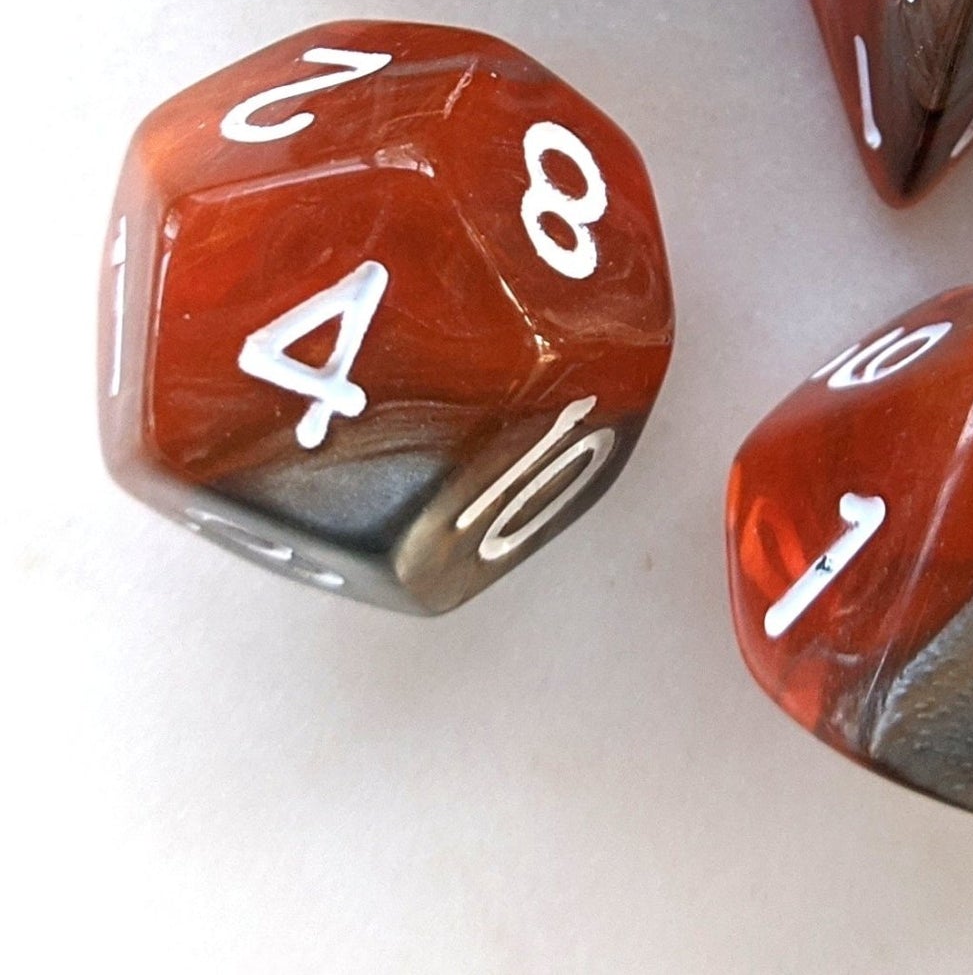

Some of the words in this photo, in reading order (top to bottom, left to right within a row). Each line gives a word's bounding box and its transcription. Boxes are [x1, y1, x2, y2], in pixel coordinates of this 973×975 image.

[220, 47, 391, 142] 2
[855, 35, 882, 150] 1
[521, 121, 607, 278] 8
[238, 261, 388, 448] 4
[456, 396, 614, 560] 10
[765, 492, 885, 638] 1
